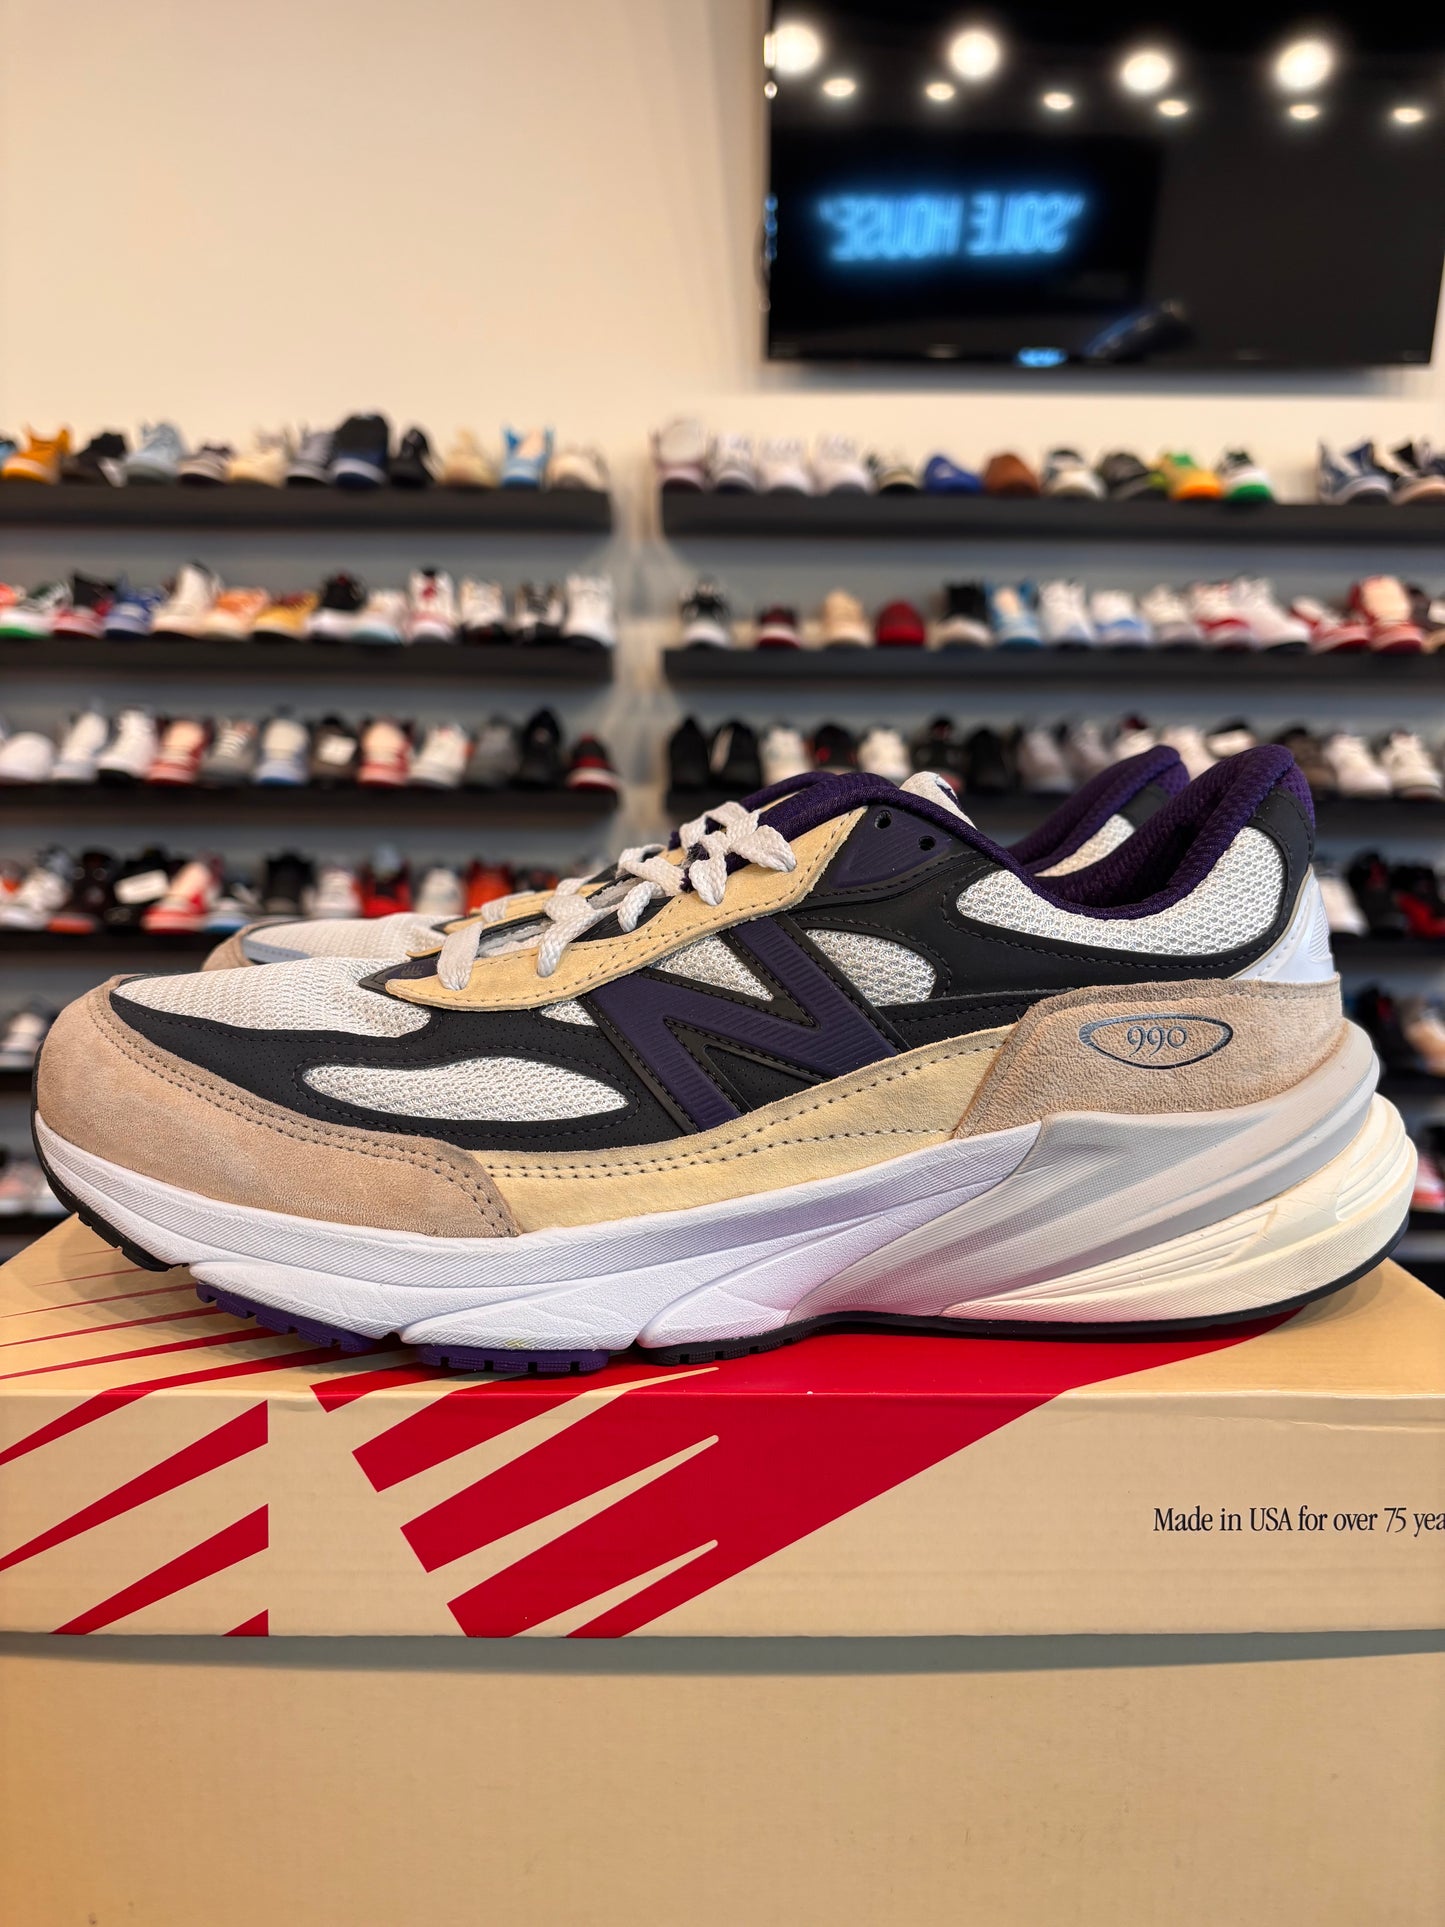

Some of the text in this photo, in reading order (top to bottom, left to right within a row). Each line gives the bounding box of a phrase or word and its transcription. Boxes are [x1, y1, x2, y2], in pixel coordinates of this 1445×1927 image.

[1127, 1025, 1188, 1057] 990
[1153, 1505, 1213, 1532] Made
[1219, 1507, 1242, 1531] in
[1250, 1507, 1292, 1532] USA
[1298, 1505, 1328, 1531] for
[1333, 1512, 1378, 1532] over
[1384, 1507, 1407, 1533] 75
